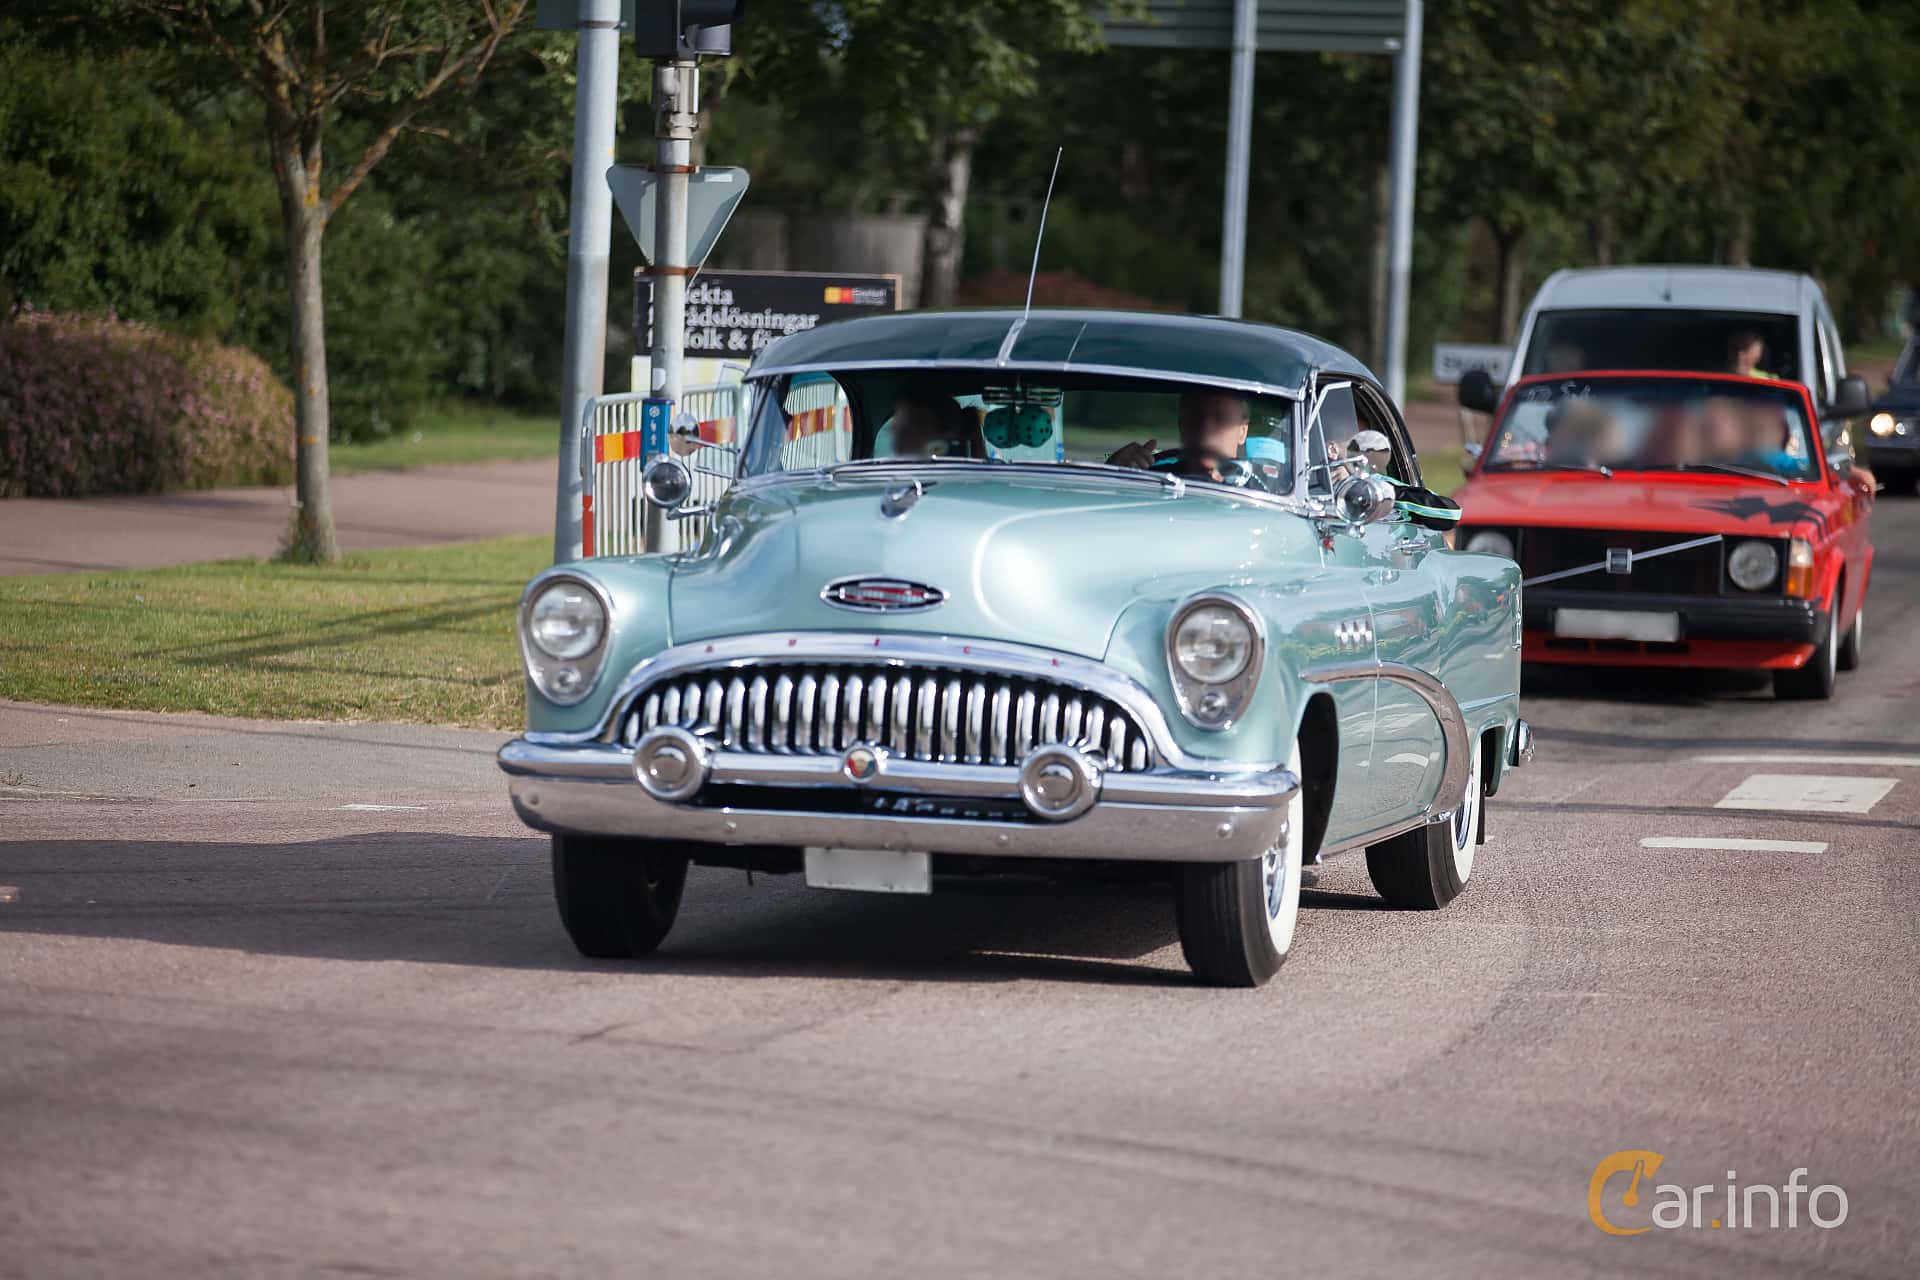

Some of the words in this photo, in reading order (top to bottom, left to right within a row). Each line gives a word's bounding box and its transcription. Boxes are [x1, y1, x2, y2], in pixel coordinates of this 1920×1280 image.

[648, 304, 820, 335] ådslösningar
[684, 326, 723, 350] folk
[728, 328, 748, 351] &
